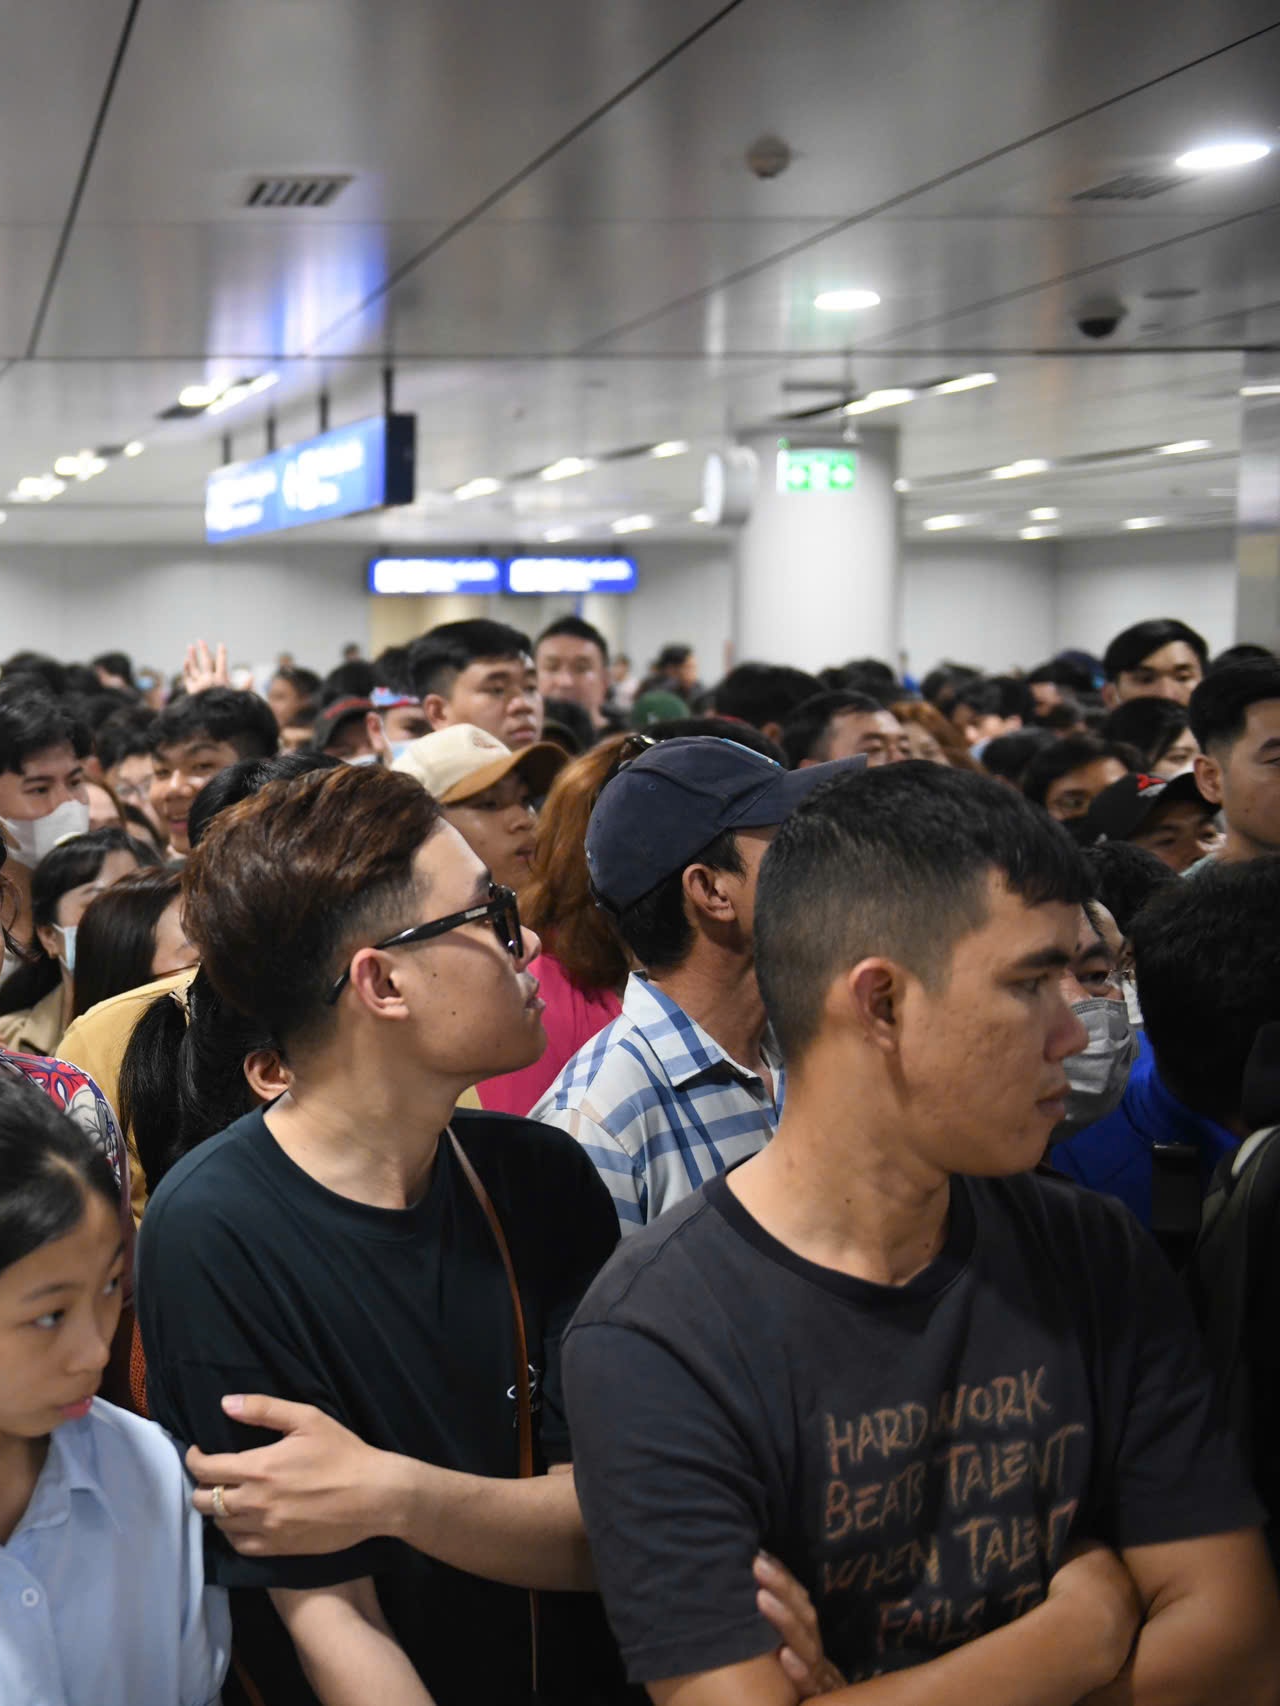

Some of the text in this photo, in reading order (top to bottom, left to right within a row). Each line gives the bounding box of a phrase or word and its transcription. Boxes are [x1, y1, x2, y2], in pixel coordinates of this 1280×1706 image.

[826, 1364, 1052, 1475] HARD WORK
[825, 1423, 1085, 1541] BEATS TALENT
[823, 1537, 941, 1595] WHEN
